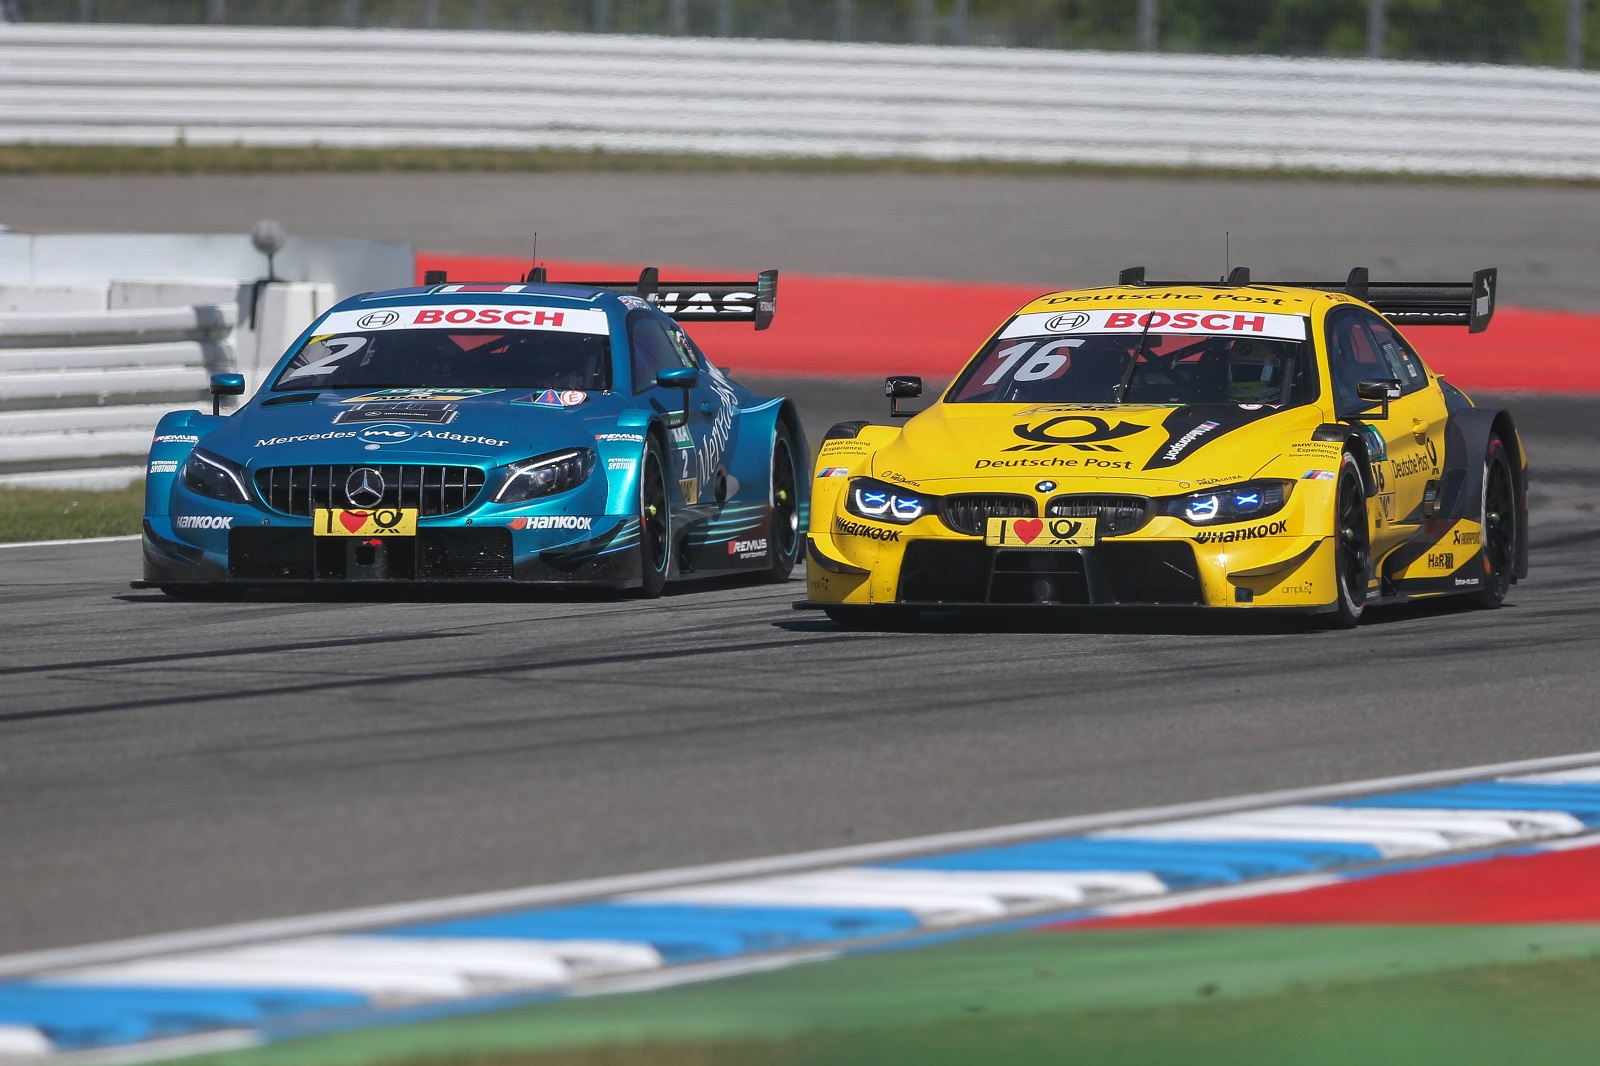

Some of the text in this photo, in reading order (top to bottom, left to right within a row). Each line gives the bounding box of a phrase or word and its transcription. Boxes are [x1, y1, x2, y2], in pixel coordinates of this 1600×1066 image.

[1047, 292, 1293, 306] Deutsche Post
[413, 309, 565, 327] BOSCH
[1104, 311, 1266, 332] BOSCH
[289, 336, 368, 377] 2
[982, 338, 1086, 386] 16
[156, 434, 199, 442] REMUS
[254, 428, 510, 448] Mercedes me Adapter
[1163, 426, 1206, 461] Motorsport
[1313, 442, 1340, 451] Driving
[1296, 447, 1338, 455] Experience
[682, 448, 688, 479] 2
[974, 456, 1134, 470] Deutsche Post
[1391, 452, 1430, 479] Deutsche Post
[999, 519, 1007, 544] I
[733, 538, 768, 552] REMUS
[1428, 553, 1445, 568] H&R
[1281, 584, 1309, 595] amplus
